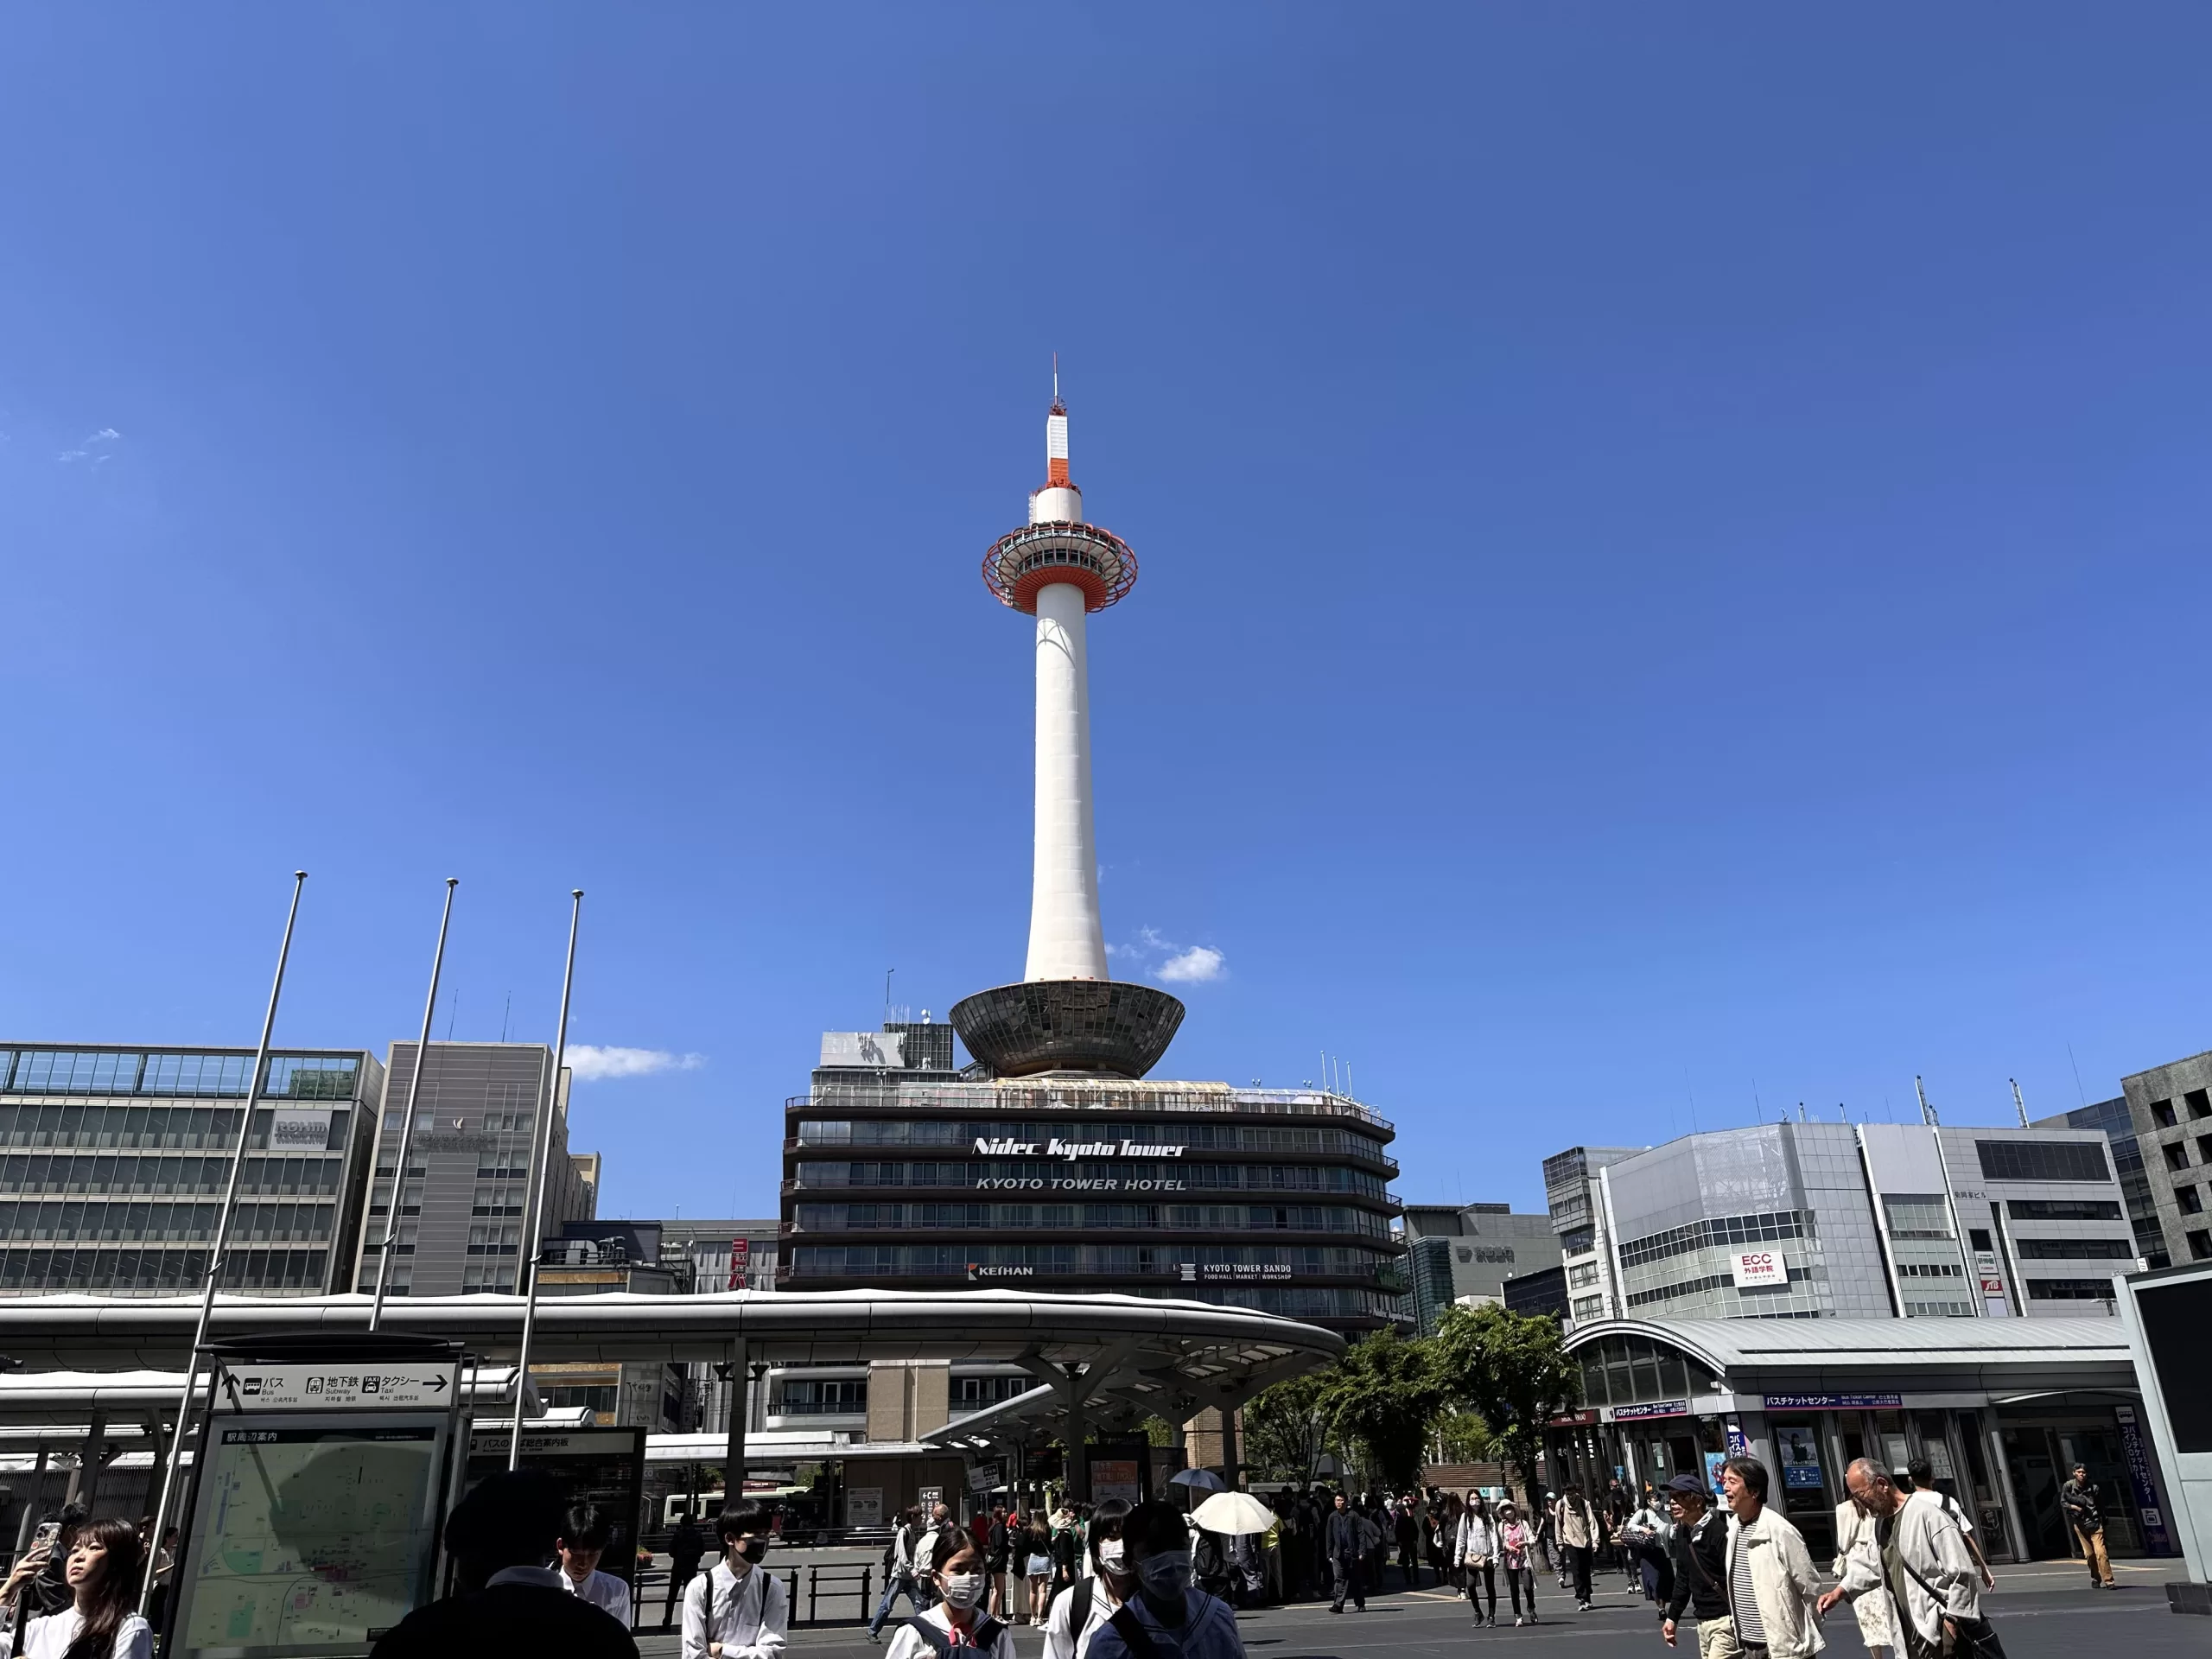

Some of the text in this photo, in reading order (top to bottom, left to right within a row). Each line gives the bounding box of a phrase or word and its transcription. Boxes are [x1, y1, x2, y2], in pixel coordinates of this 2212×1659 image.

[972, 1137, 1189, 1161] Nidec Kyoto Tower
[976, 1178, 1187, 1191] KYOTO TOWER HOTEL
[1742, 1254, 1772, 1266] ECC
[979, 1266, 1033, 1275] KEIHAN
[1204, 1264, 1291, 1273] KYOTO TOWER SANDO
[1744, 1265, 1774, 1274] 外語学院
[1985, 1281, 1999, 1291] JTB
[263, 1377, 284, 1388] バス
[327, 1376, 359, 1388] 地下鉄
[382, 1376, 420, 1387] タクシー
[1766, 1396, 1836, 1406] バスチケットセンター
[1616, 1407, 1651, 1417] バスチケットセンター
[226, 1432, 277, 1442] 駅周辺案内
[482, 1437, 569, 1448] バスのば総合案内板
[2122, 1427, 2139, 1480] コインロッカー
[2129, 1426, 2152, 1503] バスチケットセンター
